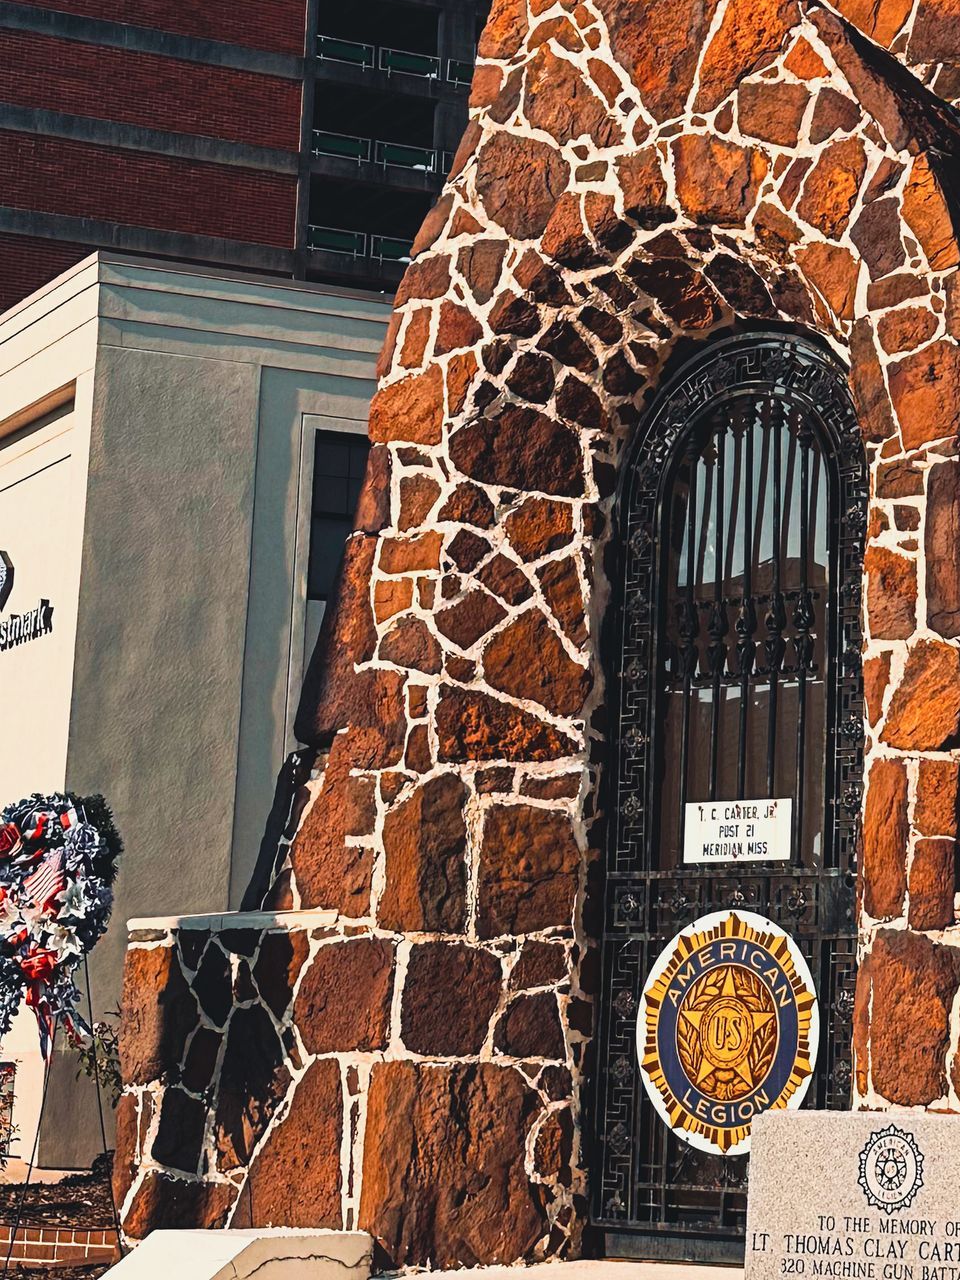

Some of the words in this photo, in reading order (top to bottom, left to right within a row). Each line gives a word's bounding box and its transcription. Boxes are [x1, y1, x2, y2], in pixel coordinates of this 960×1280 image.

[719, 825, 740, 838] POST
[746, 824, 754, 837] 21
[668, 942, 792, 1009] AMERICAN
[682, 1088, 770, 1123] LEGION
[817, 1215, 836, 1232] TO
[843, 1216, 870, 1233] THE
[879, 1218, 937, 1236] MEMORY
[783, 1234, 854, 1256] THOMAS
[864, 1238, 908, 1259] CLAY
[781, 1258, 805, 1274] 320
[812, 1259, 876, 1279] MACHINE
[883, 1263, 914, 1280] GUN
